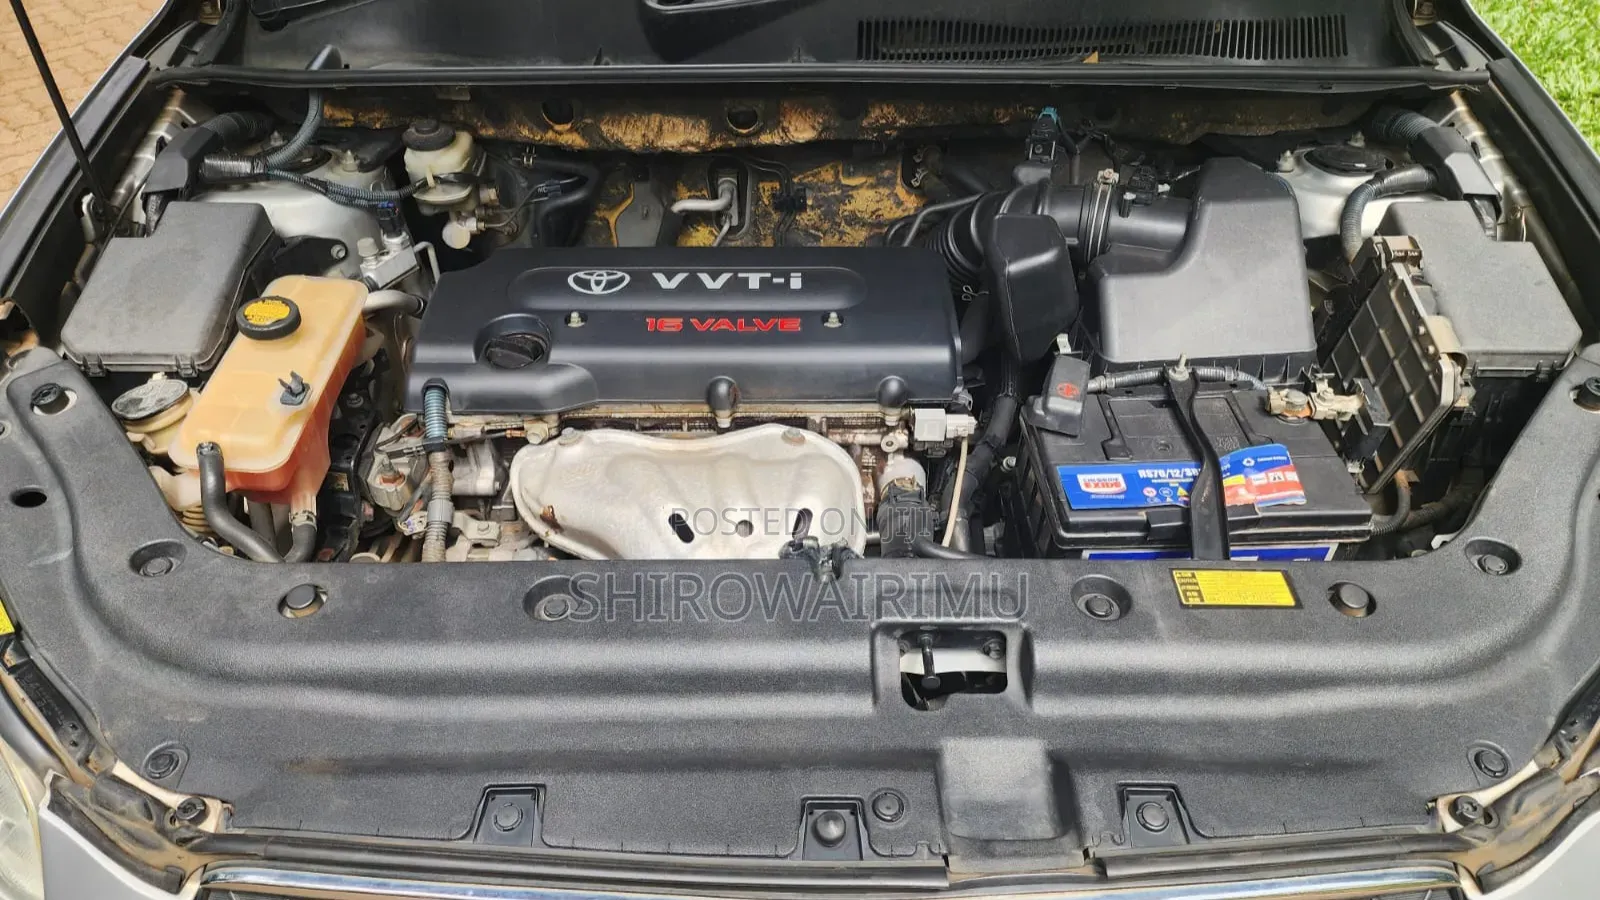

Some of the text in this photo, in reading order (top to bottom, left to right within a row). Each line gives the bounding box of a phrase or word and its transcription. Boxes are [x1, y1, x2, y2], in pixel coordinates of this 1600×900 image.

[651, 272, 802, 290] VVT-i
[646, 318, 801, 332] 16 VALVE
[1083, 481, 1122, 489] EXIDE
